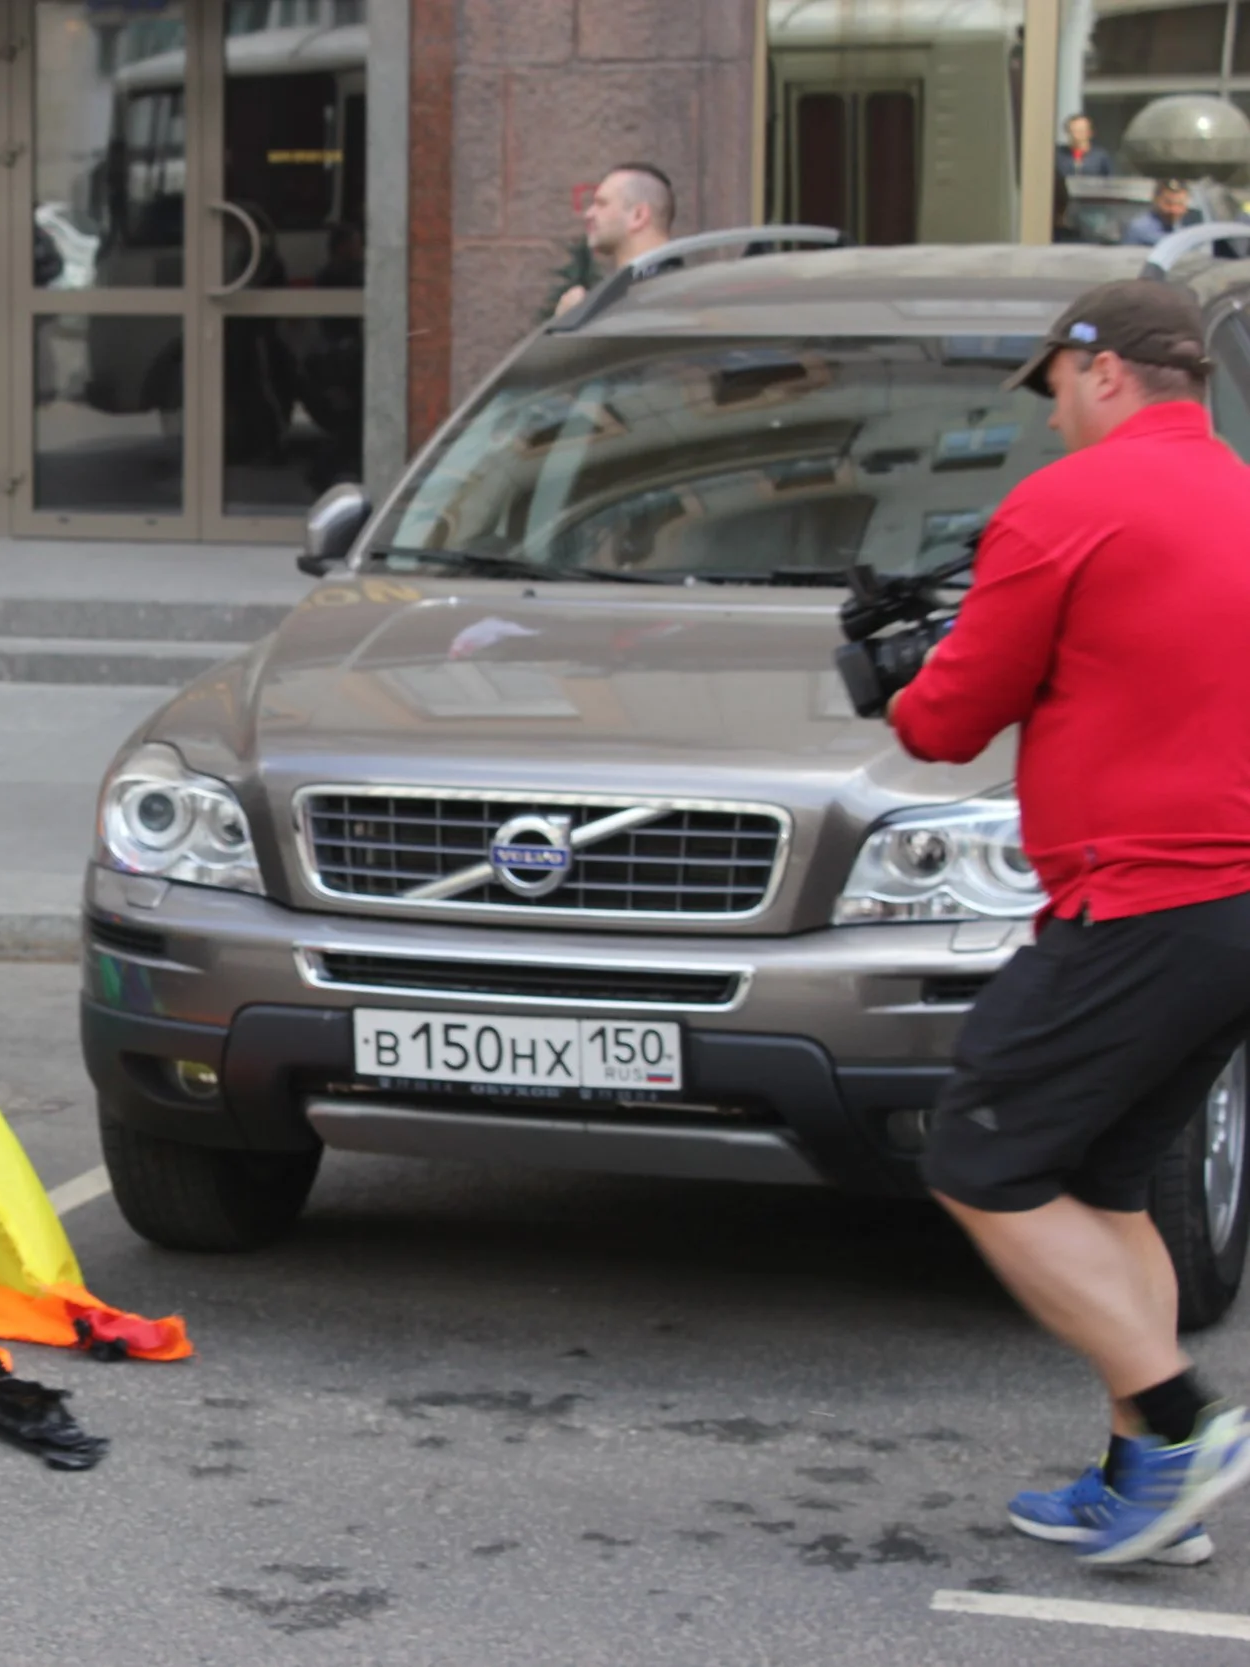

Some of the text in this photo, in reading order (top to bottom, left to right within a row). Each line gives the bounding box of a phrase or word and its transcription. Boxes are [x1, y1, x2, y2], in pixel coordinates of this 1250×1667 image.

[497, 849, 563, 865] VOLVO
[588, 1026, 665, 1066] 150
[604, 1066, 643, 1082] RUS
